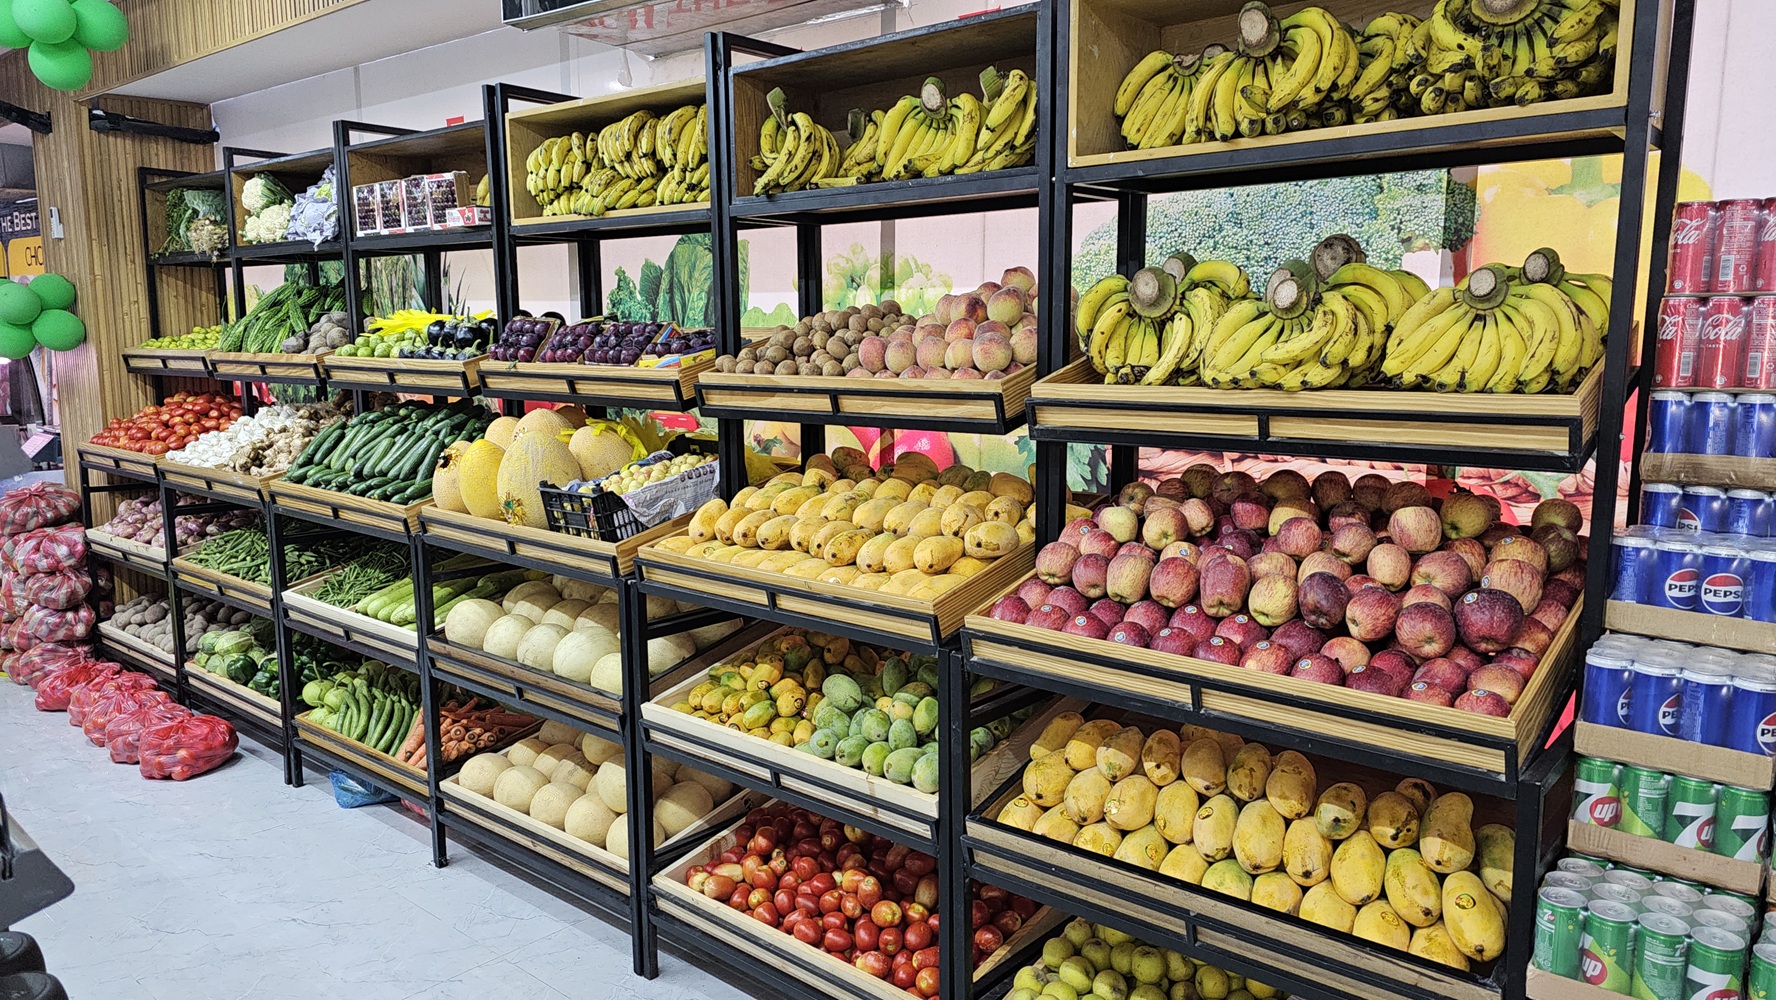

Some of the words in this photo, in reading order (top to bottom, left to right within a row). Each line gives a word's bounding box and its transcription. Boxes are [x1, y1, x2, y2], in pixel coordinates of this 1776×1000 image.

[1, 215, 13, 233] HE
[13, 211, 37, 232] BEST
[1672, 217, 1708, 246] ola
[25, 245, 44, 267] CHO
[1701, 312, 1745, 341] Cola
